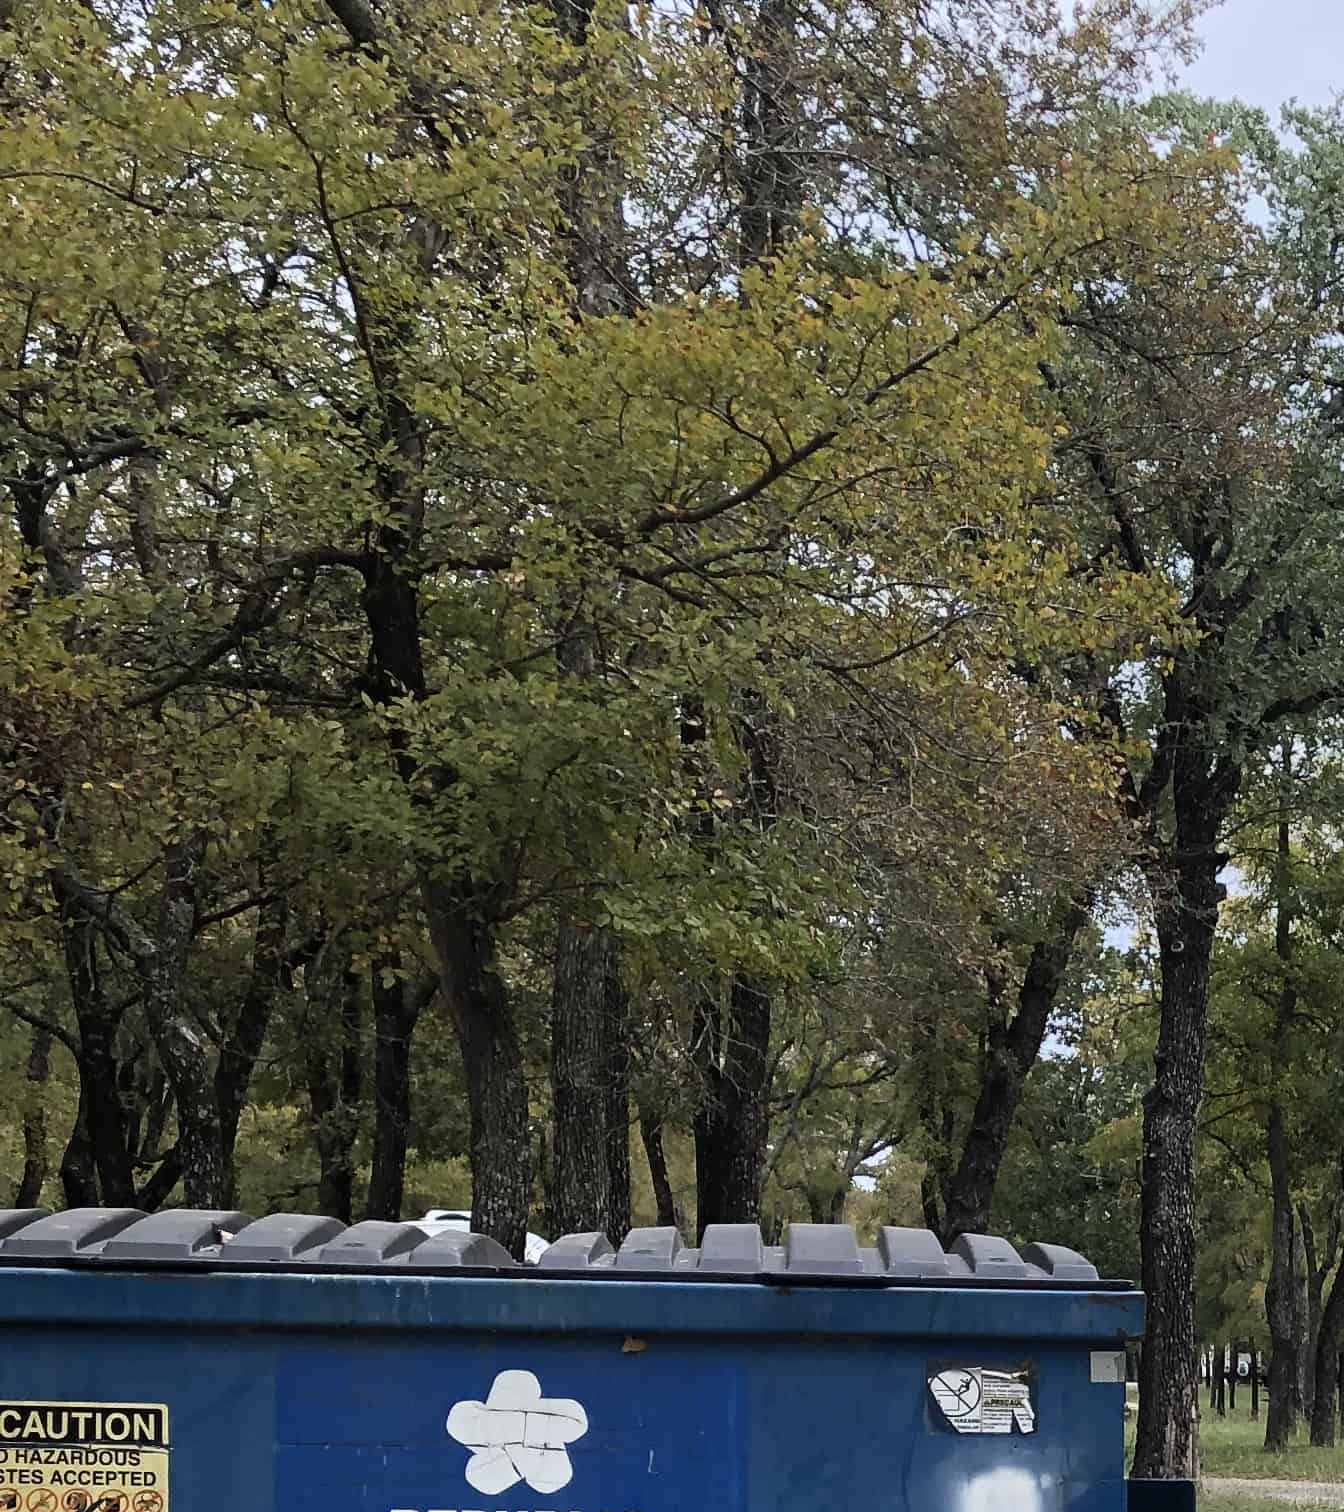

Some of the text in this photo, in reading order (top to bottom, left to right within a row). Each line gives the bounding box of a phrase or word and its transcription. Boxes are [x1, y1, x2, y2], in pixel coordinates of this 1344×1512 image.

[0, 1409, 155, 1441] CAUTION
[15, 1450, 141, 1466] HAZARDOUS
[50, 1469, 156, 1486] ACCEPTED
